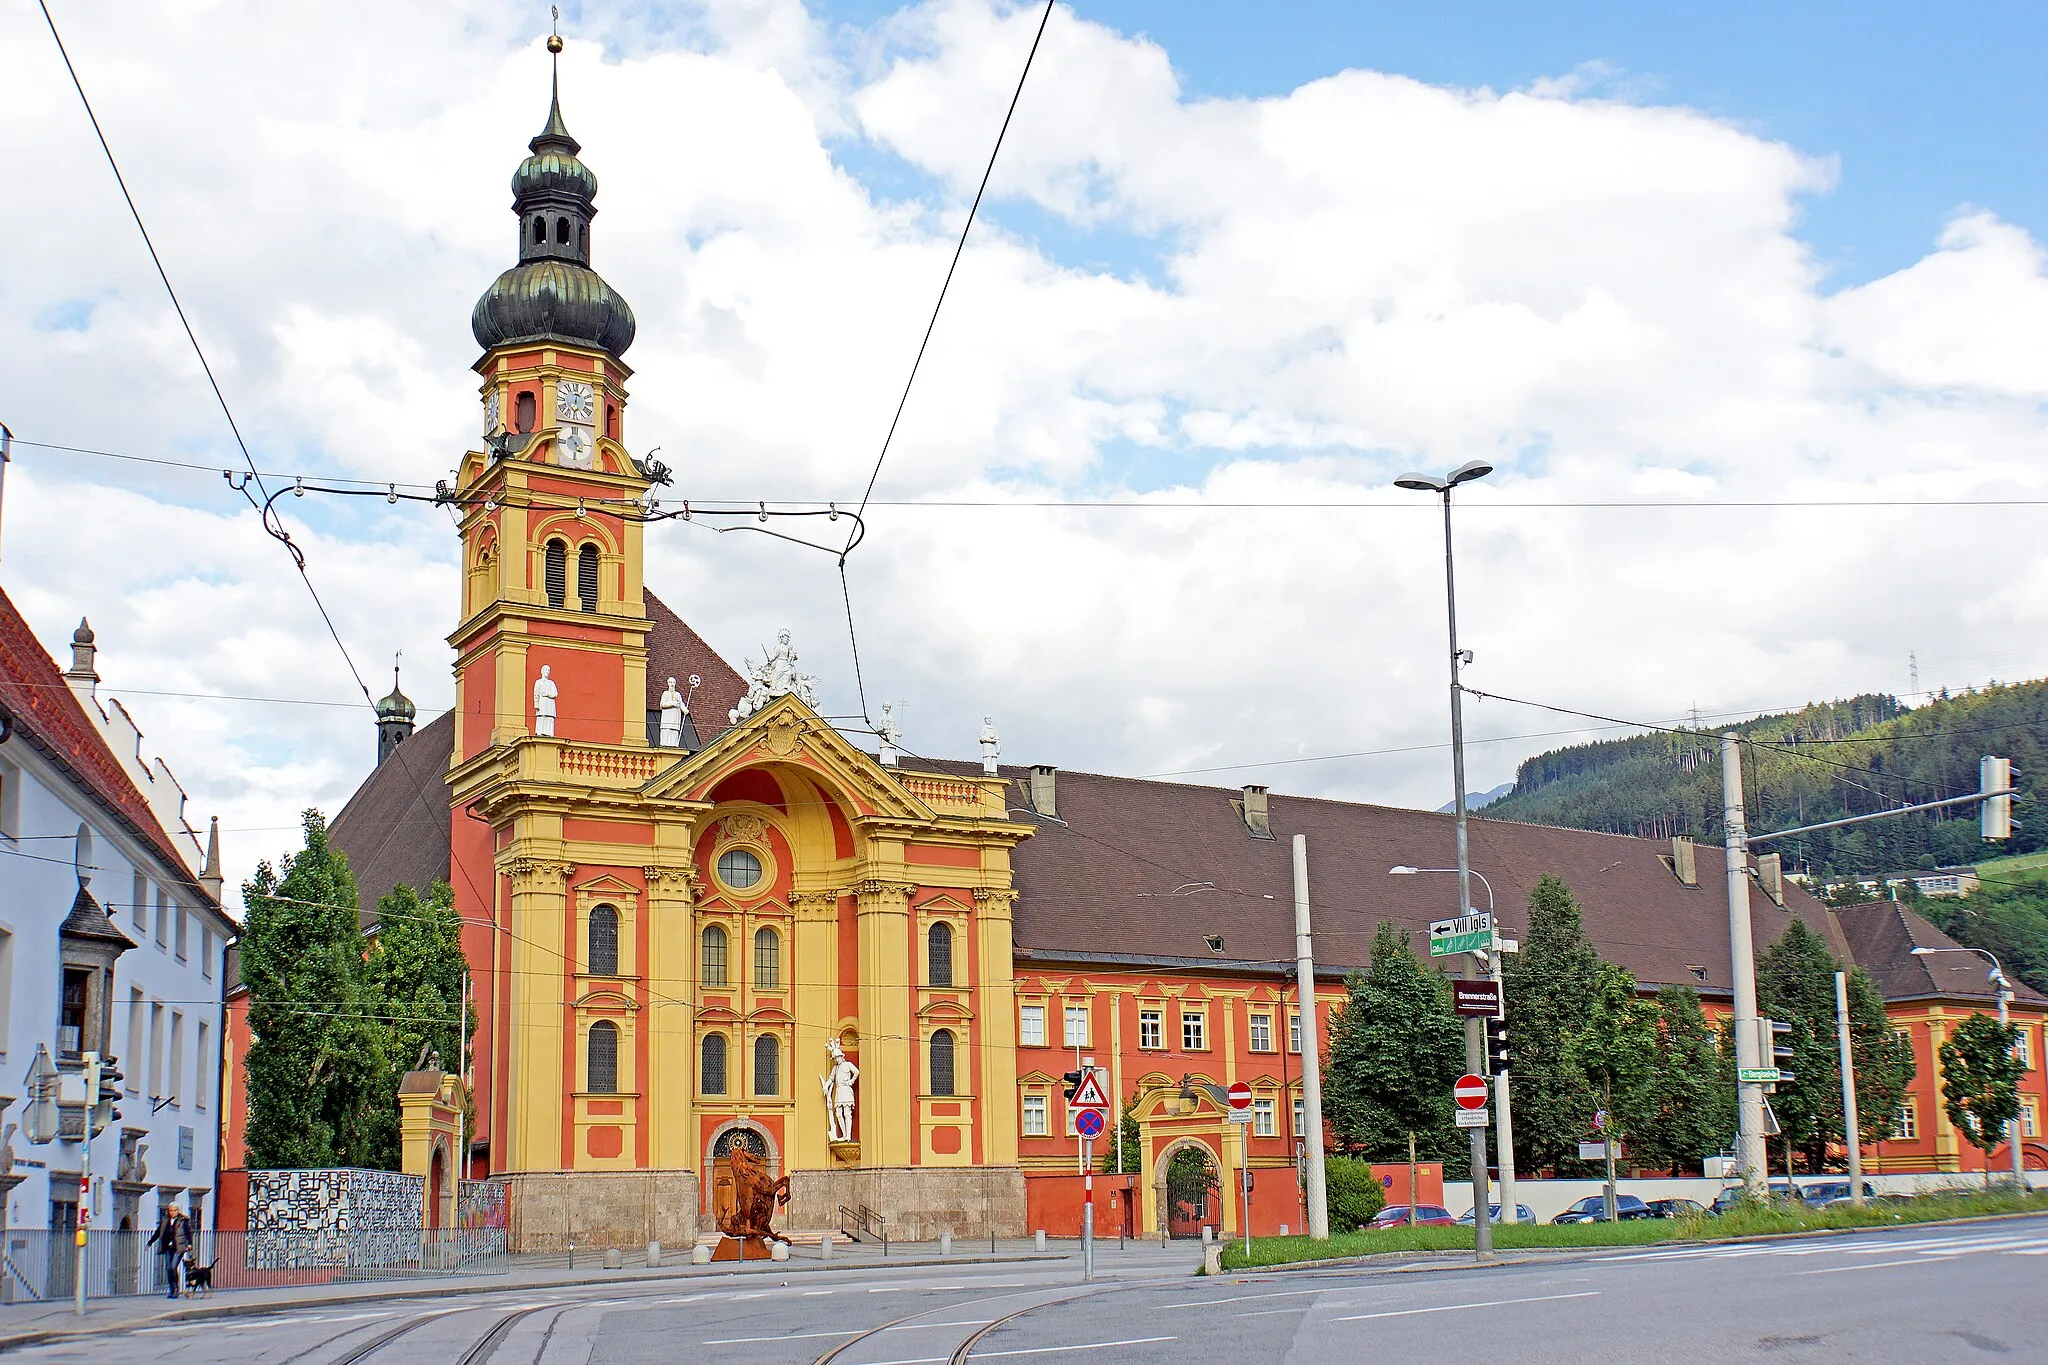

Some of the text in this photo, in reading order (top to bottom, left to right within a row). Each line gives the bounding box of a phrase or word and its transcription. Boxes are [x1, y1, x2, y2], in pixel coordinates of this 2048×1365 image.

[1453, 915, 1487, 933] Vill Igls
[1458, 991, 1497, 1001] Brennerstraße
